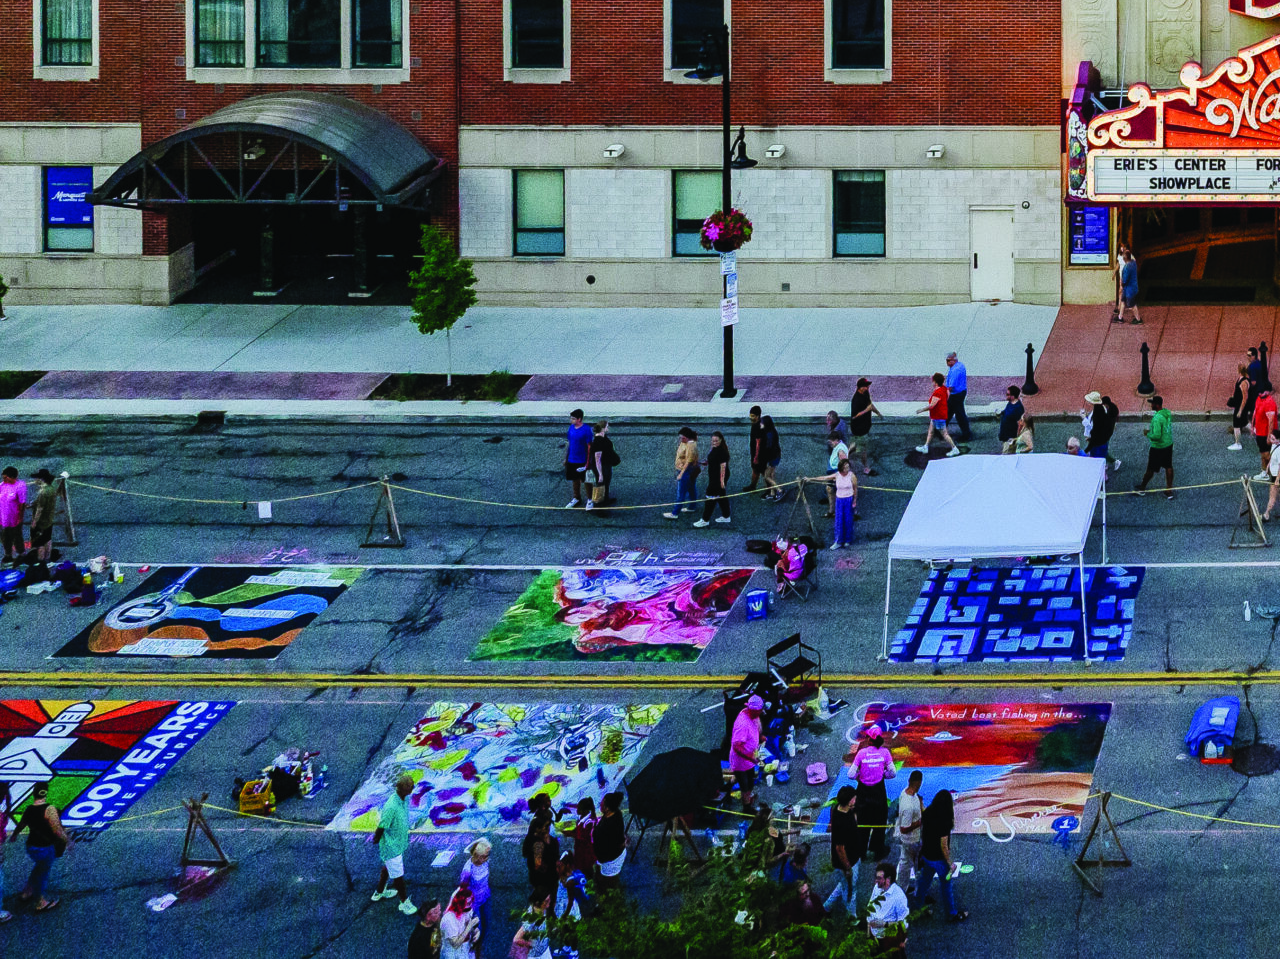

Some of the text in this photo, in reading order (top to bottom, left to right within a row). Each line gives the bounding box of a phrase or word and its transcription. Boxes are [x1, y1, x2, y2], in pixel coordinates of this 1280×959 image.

[1113, 158, 1158, 171] ERIE'S
[1174, 158, 1227, 171] CENTER
[1149, 176, 1231, 190] SHOWPLACE
[930, 708, 967, 719] Voted
[971, 708, 997, 719] best
[1001, 708, 1037, 722] fishing
[1040, 711, 1050, 719] in
[92, 703, 227, 829] ERIE INSURANCE
